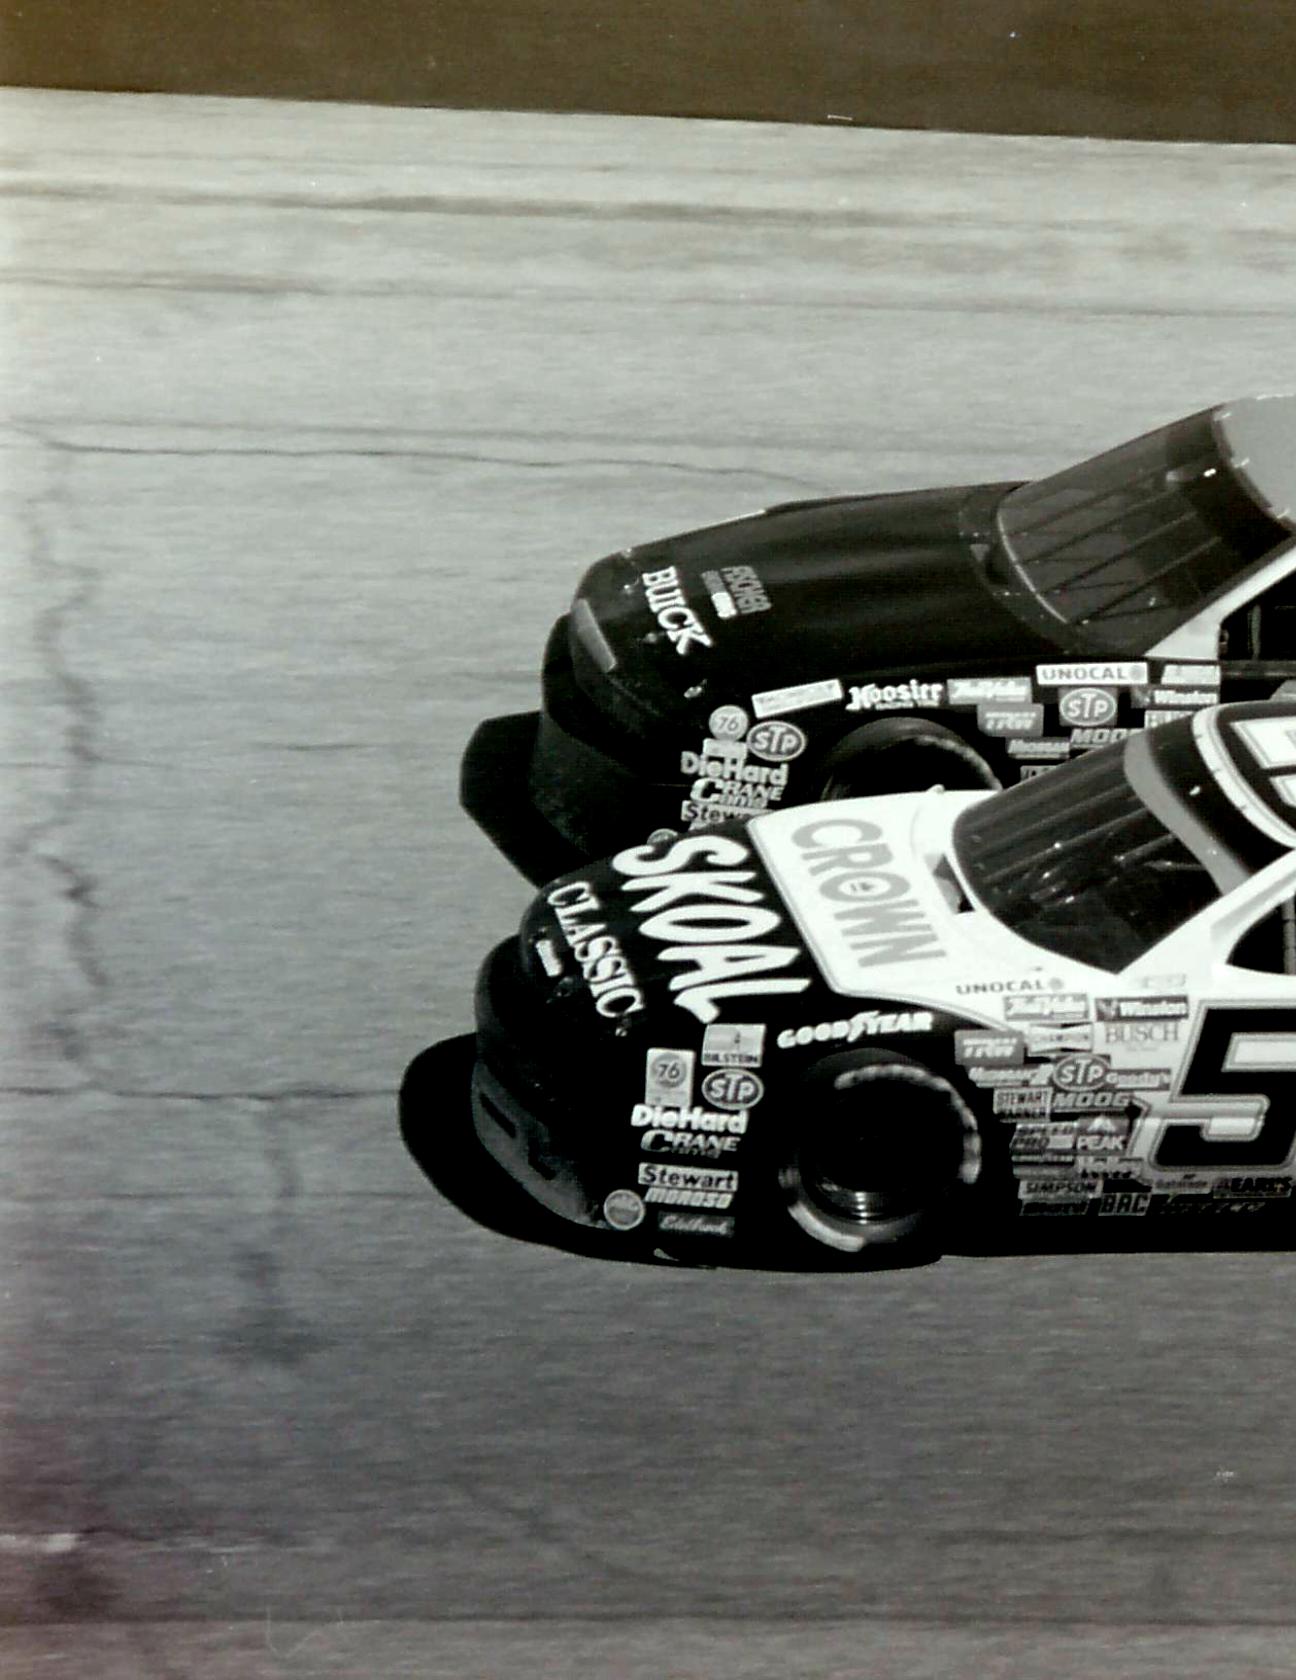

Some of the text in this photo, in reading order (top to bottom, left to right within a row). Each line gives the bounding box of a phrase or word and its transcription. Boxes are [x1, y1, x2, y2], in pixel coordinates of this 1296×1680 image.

[642, 565, 713, 655] BUICK
[1041, 667, 1127, 681] UNOCAL
[1067, 692, 1109, 719] STP
[717, 714, 739, 733] 76
[1069, 727, 1140, 745] MOO
[753, 725, 799, 753] STP
[681, 750, 789, 786] DieHard
[791, 818, 946, 968] CROWN
[612, 835, 811, 1023] SKOAL
[547, 880, 645, 1018] CLASSIC
[956, 980, 1044, 995] UNOCAL
[777, 1010, 933, 1048] GOODYEAR
[1105, 1022, 1178, 1042] BUSCH
[657, 1062, 681, 1079] 76
[1061, 1059, 1105, 1084] STP
[710, 1073, 755, 1101] STP
[1053, 1092, 1132, 1108] MOOG
[631, 1104, 748, 1134] DieHard
[641, 1130, 741, 1152] CRANE
[1077, 1136, 1126, 1151] PEAK
[643, 1164, 735, 1190] Stewart
